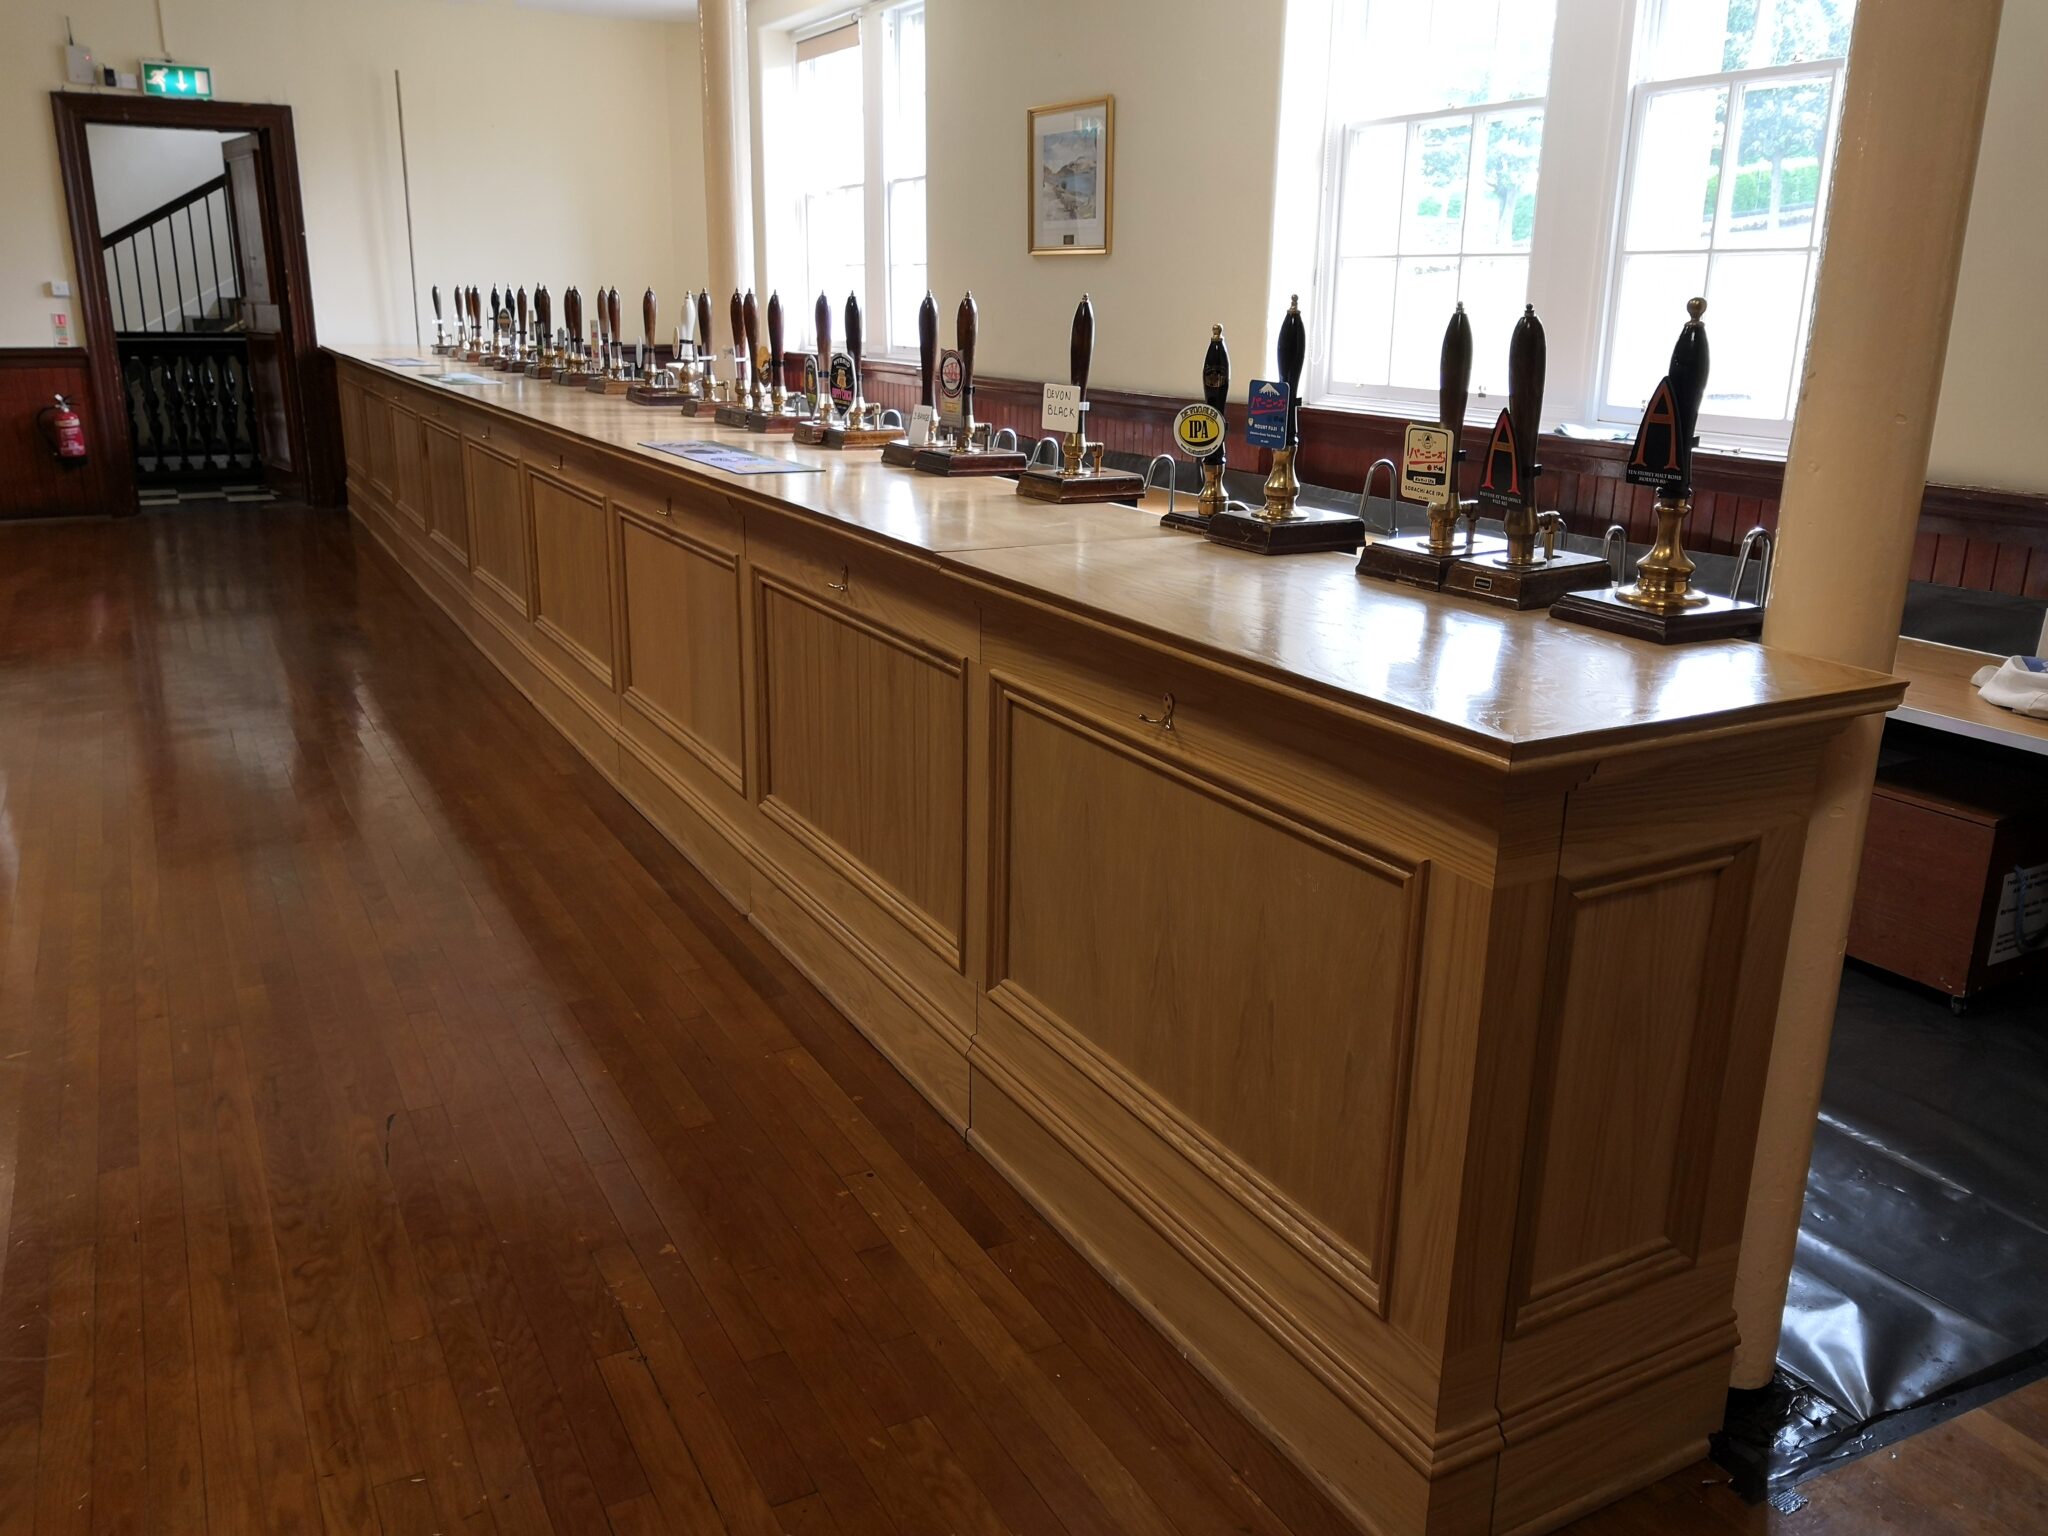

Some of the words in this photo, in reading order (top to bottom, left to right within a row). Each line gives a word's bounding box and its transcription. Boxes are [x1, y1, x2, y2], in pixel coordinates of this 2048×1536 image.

[1046, 388, 1072, 401] DEVON
[1047, 404, 1075, 418] BLACK
[1189, 420, 1209, 439] IPA
[1404, 485, 1425, 493] SORACHI
